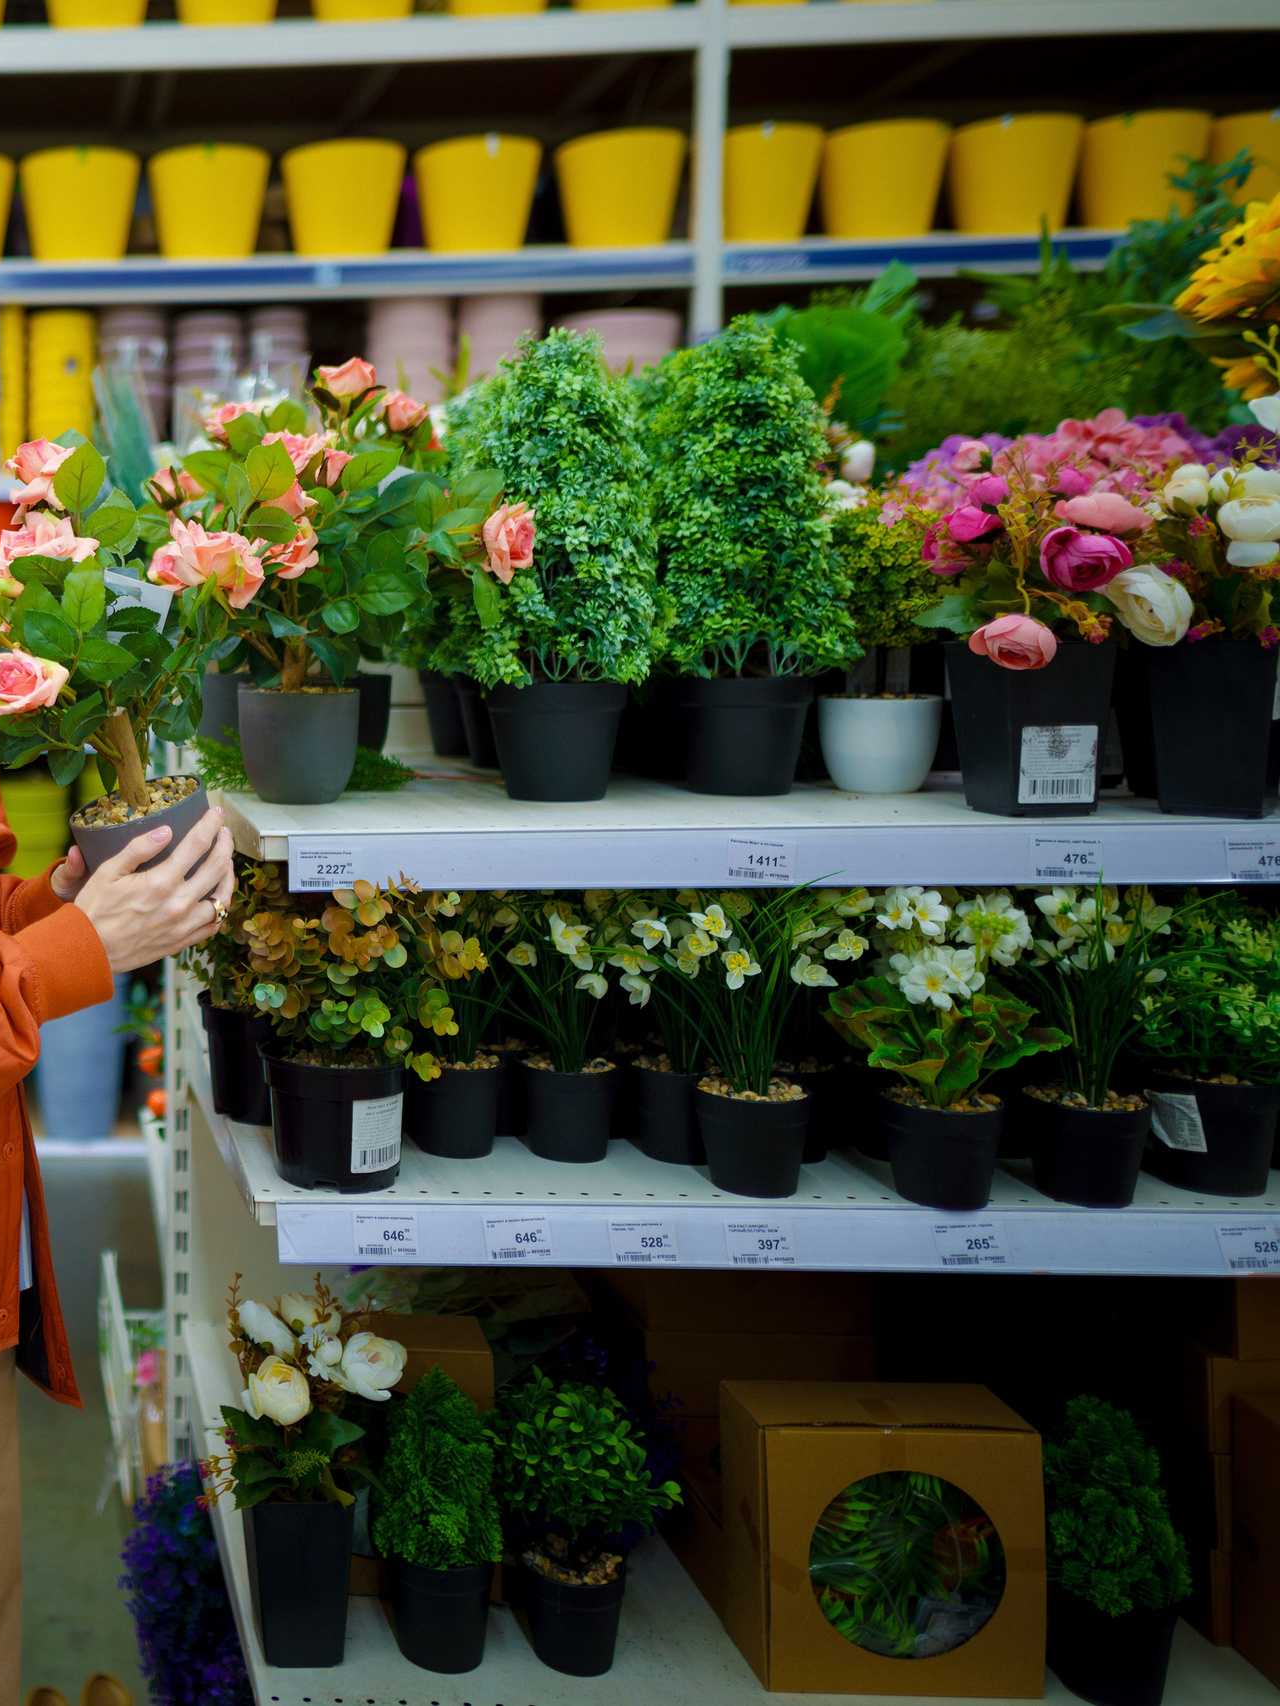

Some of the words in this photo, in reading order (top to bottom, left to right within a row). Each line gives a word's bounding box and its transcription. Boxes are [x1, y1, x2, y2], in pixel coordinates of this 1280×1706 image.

[1063, 853, 1088, 865] 476
[1258, 855, 1280, 867] 476
[383, 1230, 405, 1242] 646
[515, 1232, 537, 1244] 646
[641, 1236, 663, 1248] 528
[757, 1239, 780, 1251] 397
[966, 1238, 990, 1250] 265
[1254, 1241, 1279, 1253] 526
